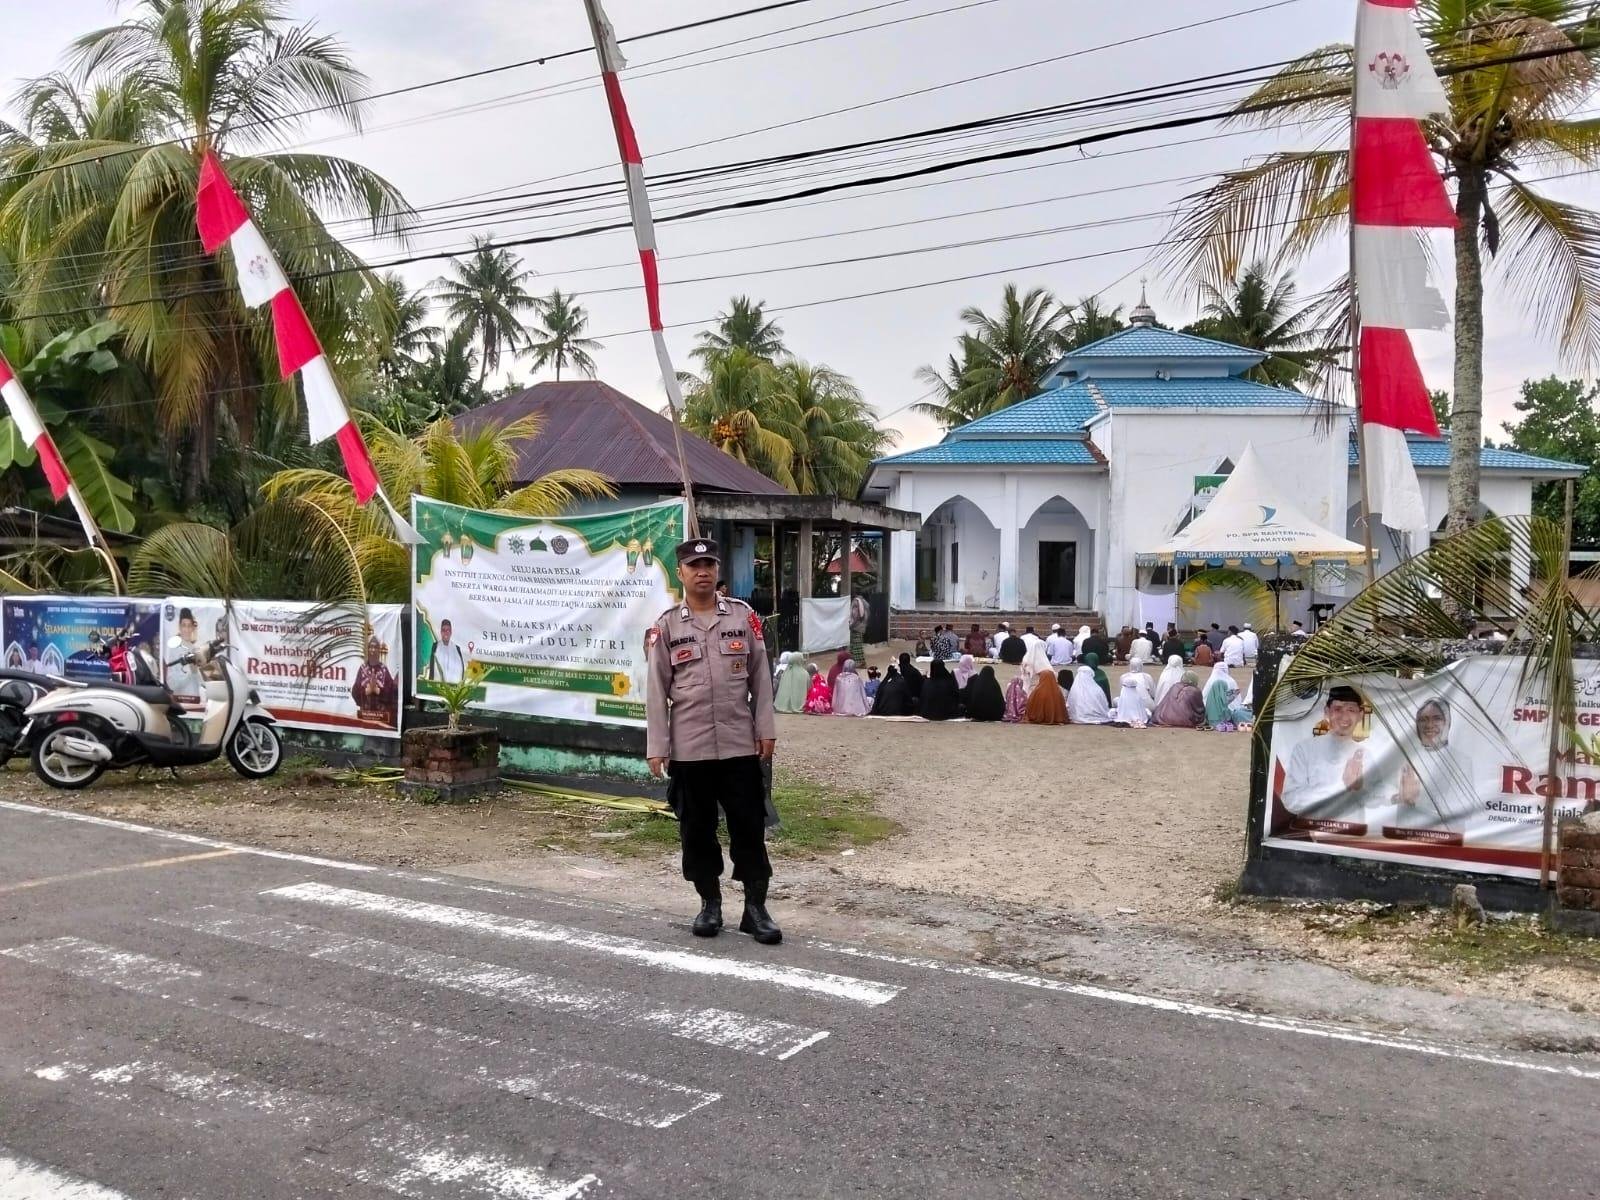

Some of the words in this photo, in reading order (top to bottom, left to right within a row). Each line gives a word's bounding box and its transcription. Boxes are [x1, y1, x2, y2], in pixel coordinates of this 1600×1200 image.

[444, 569, 476, 579] INSTITUT
[478, 572, 518, 582] TEKNOLOGI
[511, 565, 554, 575] KELUARGA
[555, 567, 581, 576] BESAR
[451, 581, 481, 590] BESERTA
[482, 583, 508, 592] WARGA
[508, 585, 568, 596] MUHAMMADIYAH
[568, 589, 606, 598] KABUPATEN
[606, 590, 646, 598] WAKATOBI
[469, 594, 501, 603] BERSAMA
[535, 599, 560, 608] MASJID
[561, 600, 584, 609] TAQWA
[585, 601, 603, 609] DESA
[604, 601, 627, 609] WAHA
[241, 623, 249, 631] SD
[250, 623, 273, 633] NEGERI
[501, 619, 593, 632] MELAKSANAKAN
[482, 630, 534, 645] SHOLAT
[540, 636, 578, 647] IDUL
[585, 638, 625, 650] FITRI
[720, 628, 746, 639] POLRI
[264, 644, 316, 659] Marhaban
[483, 649, 505, 657] MASJID
[506, 651, 530, 660] TAQWA
[549, 654, 570, 662] WAHA
[247, 657, 347, 681] Ramadhan
[1513, 708, 1550, 722] SMP
[1485, 800, 1532, 814] Selamat
[1488, 814, 1517, 823] DENGAN
